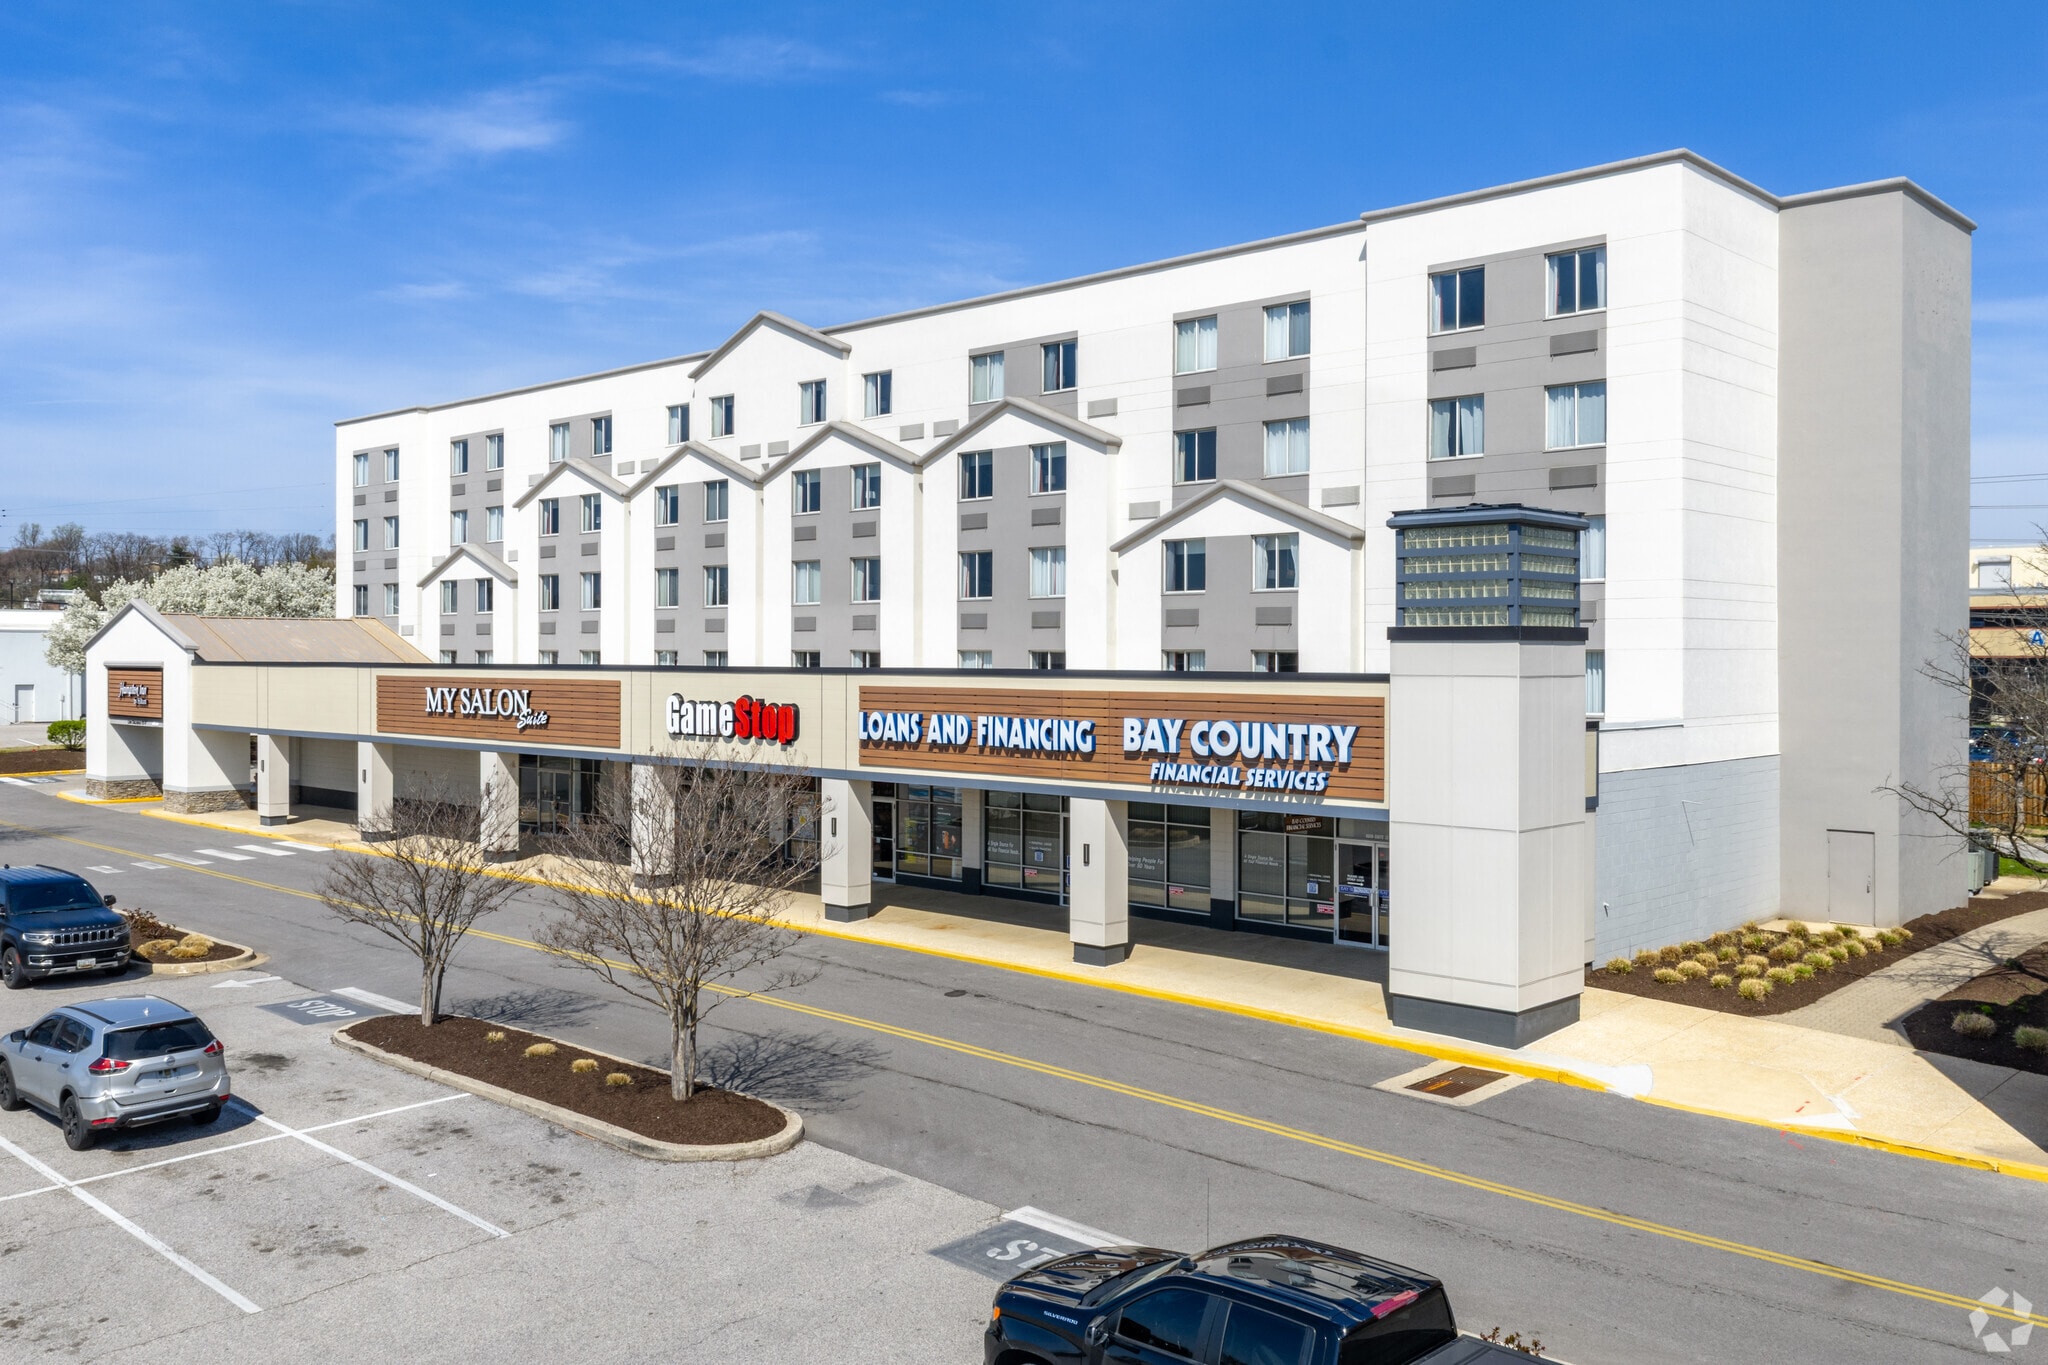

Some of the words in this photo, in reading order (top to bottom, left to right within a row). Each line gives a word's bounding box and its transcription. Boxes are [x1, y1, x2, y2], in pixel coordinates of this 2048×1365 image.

[425, 687, 457, 713] MY
[460, 687, 530, 716] SALON
[516, 708, 548, 729] Suite
[665, 694, 797, 744] GameStop
[858, 711, 922, 743] LOANS
[926, 714, 972, 745] AND
[977, 716, 1096, 753] FINANCING
[1123, 717, 1186, 753] BAY
[1190, 720, 1359, 763] COUNTRY
[1150, 762, 1241, 786] FINANCIAL
[1244, 768, 1329, 792] SERVICES
[286, 999, 357, 1017] STOP
[985, 1239, 1069, 1270] ST
[1043, 1309, 1079, 1326] SILVERADO
